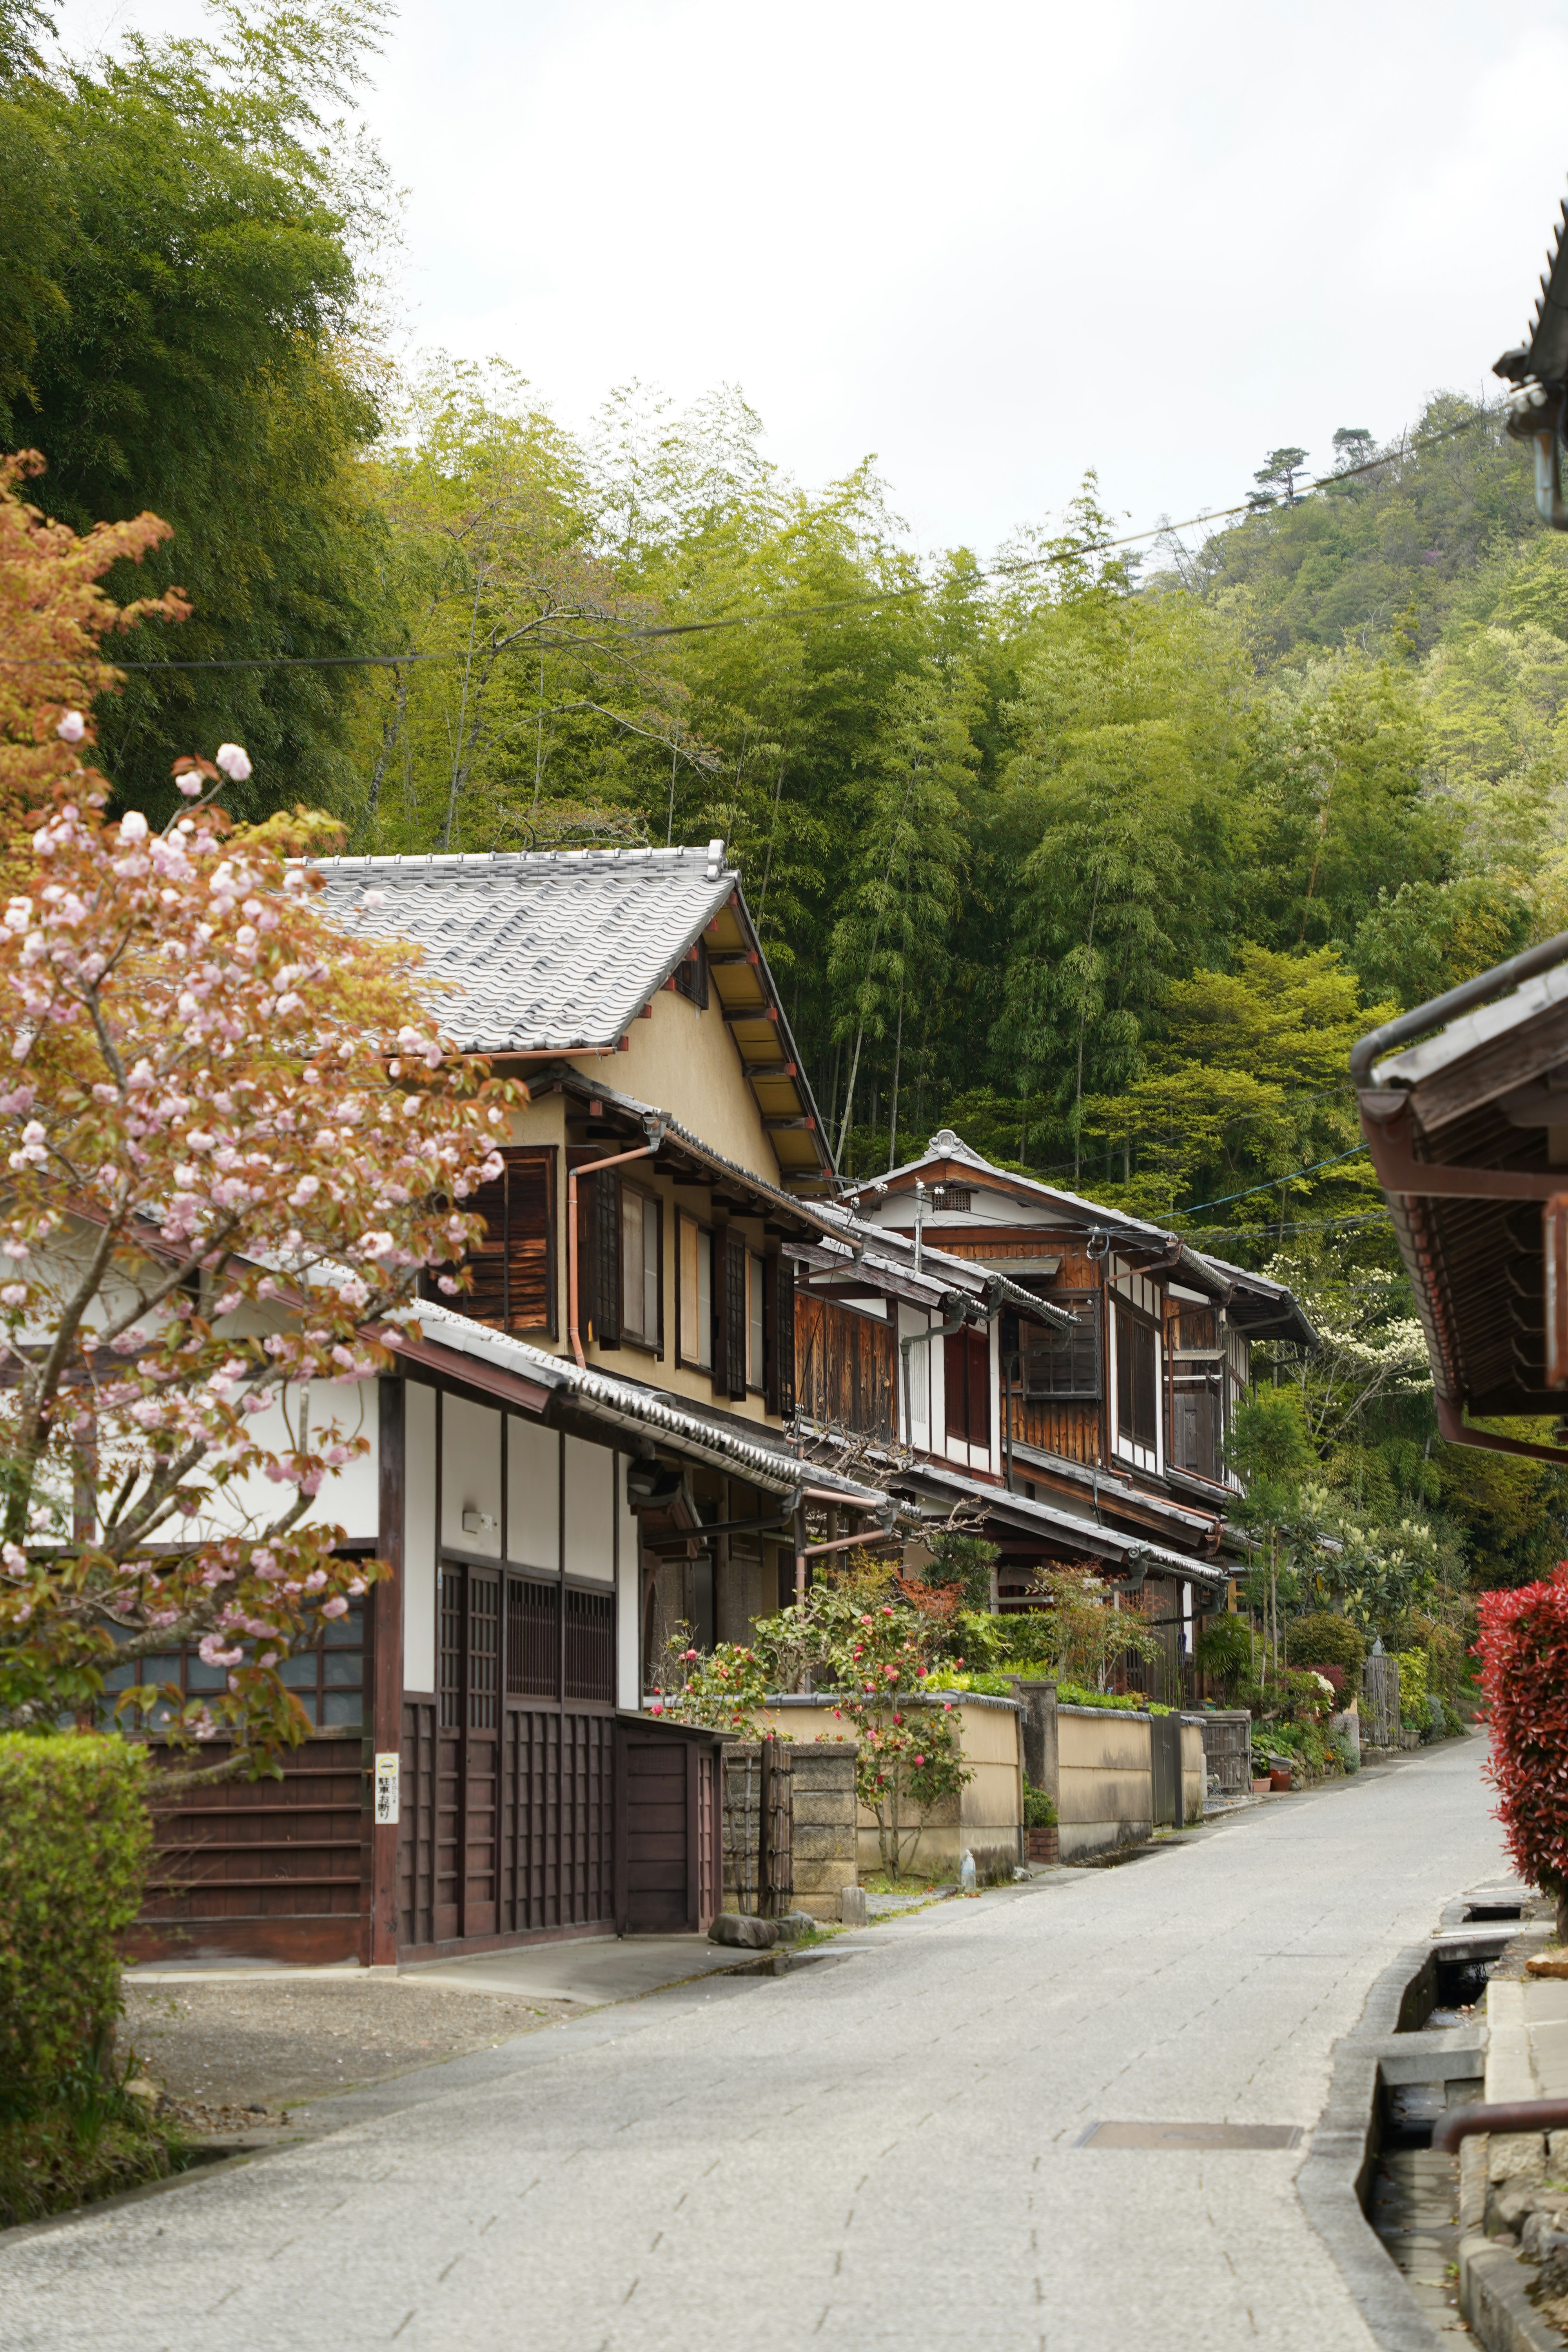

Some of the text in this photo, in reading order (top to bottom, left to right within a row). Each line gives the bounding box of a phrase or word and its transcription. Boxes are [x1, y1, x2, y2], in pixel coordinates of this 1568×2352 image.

[378, 1777, 390, 1820] 駐車お断り
